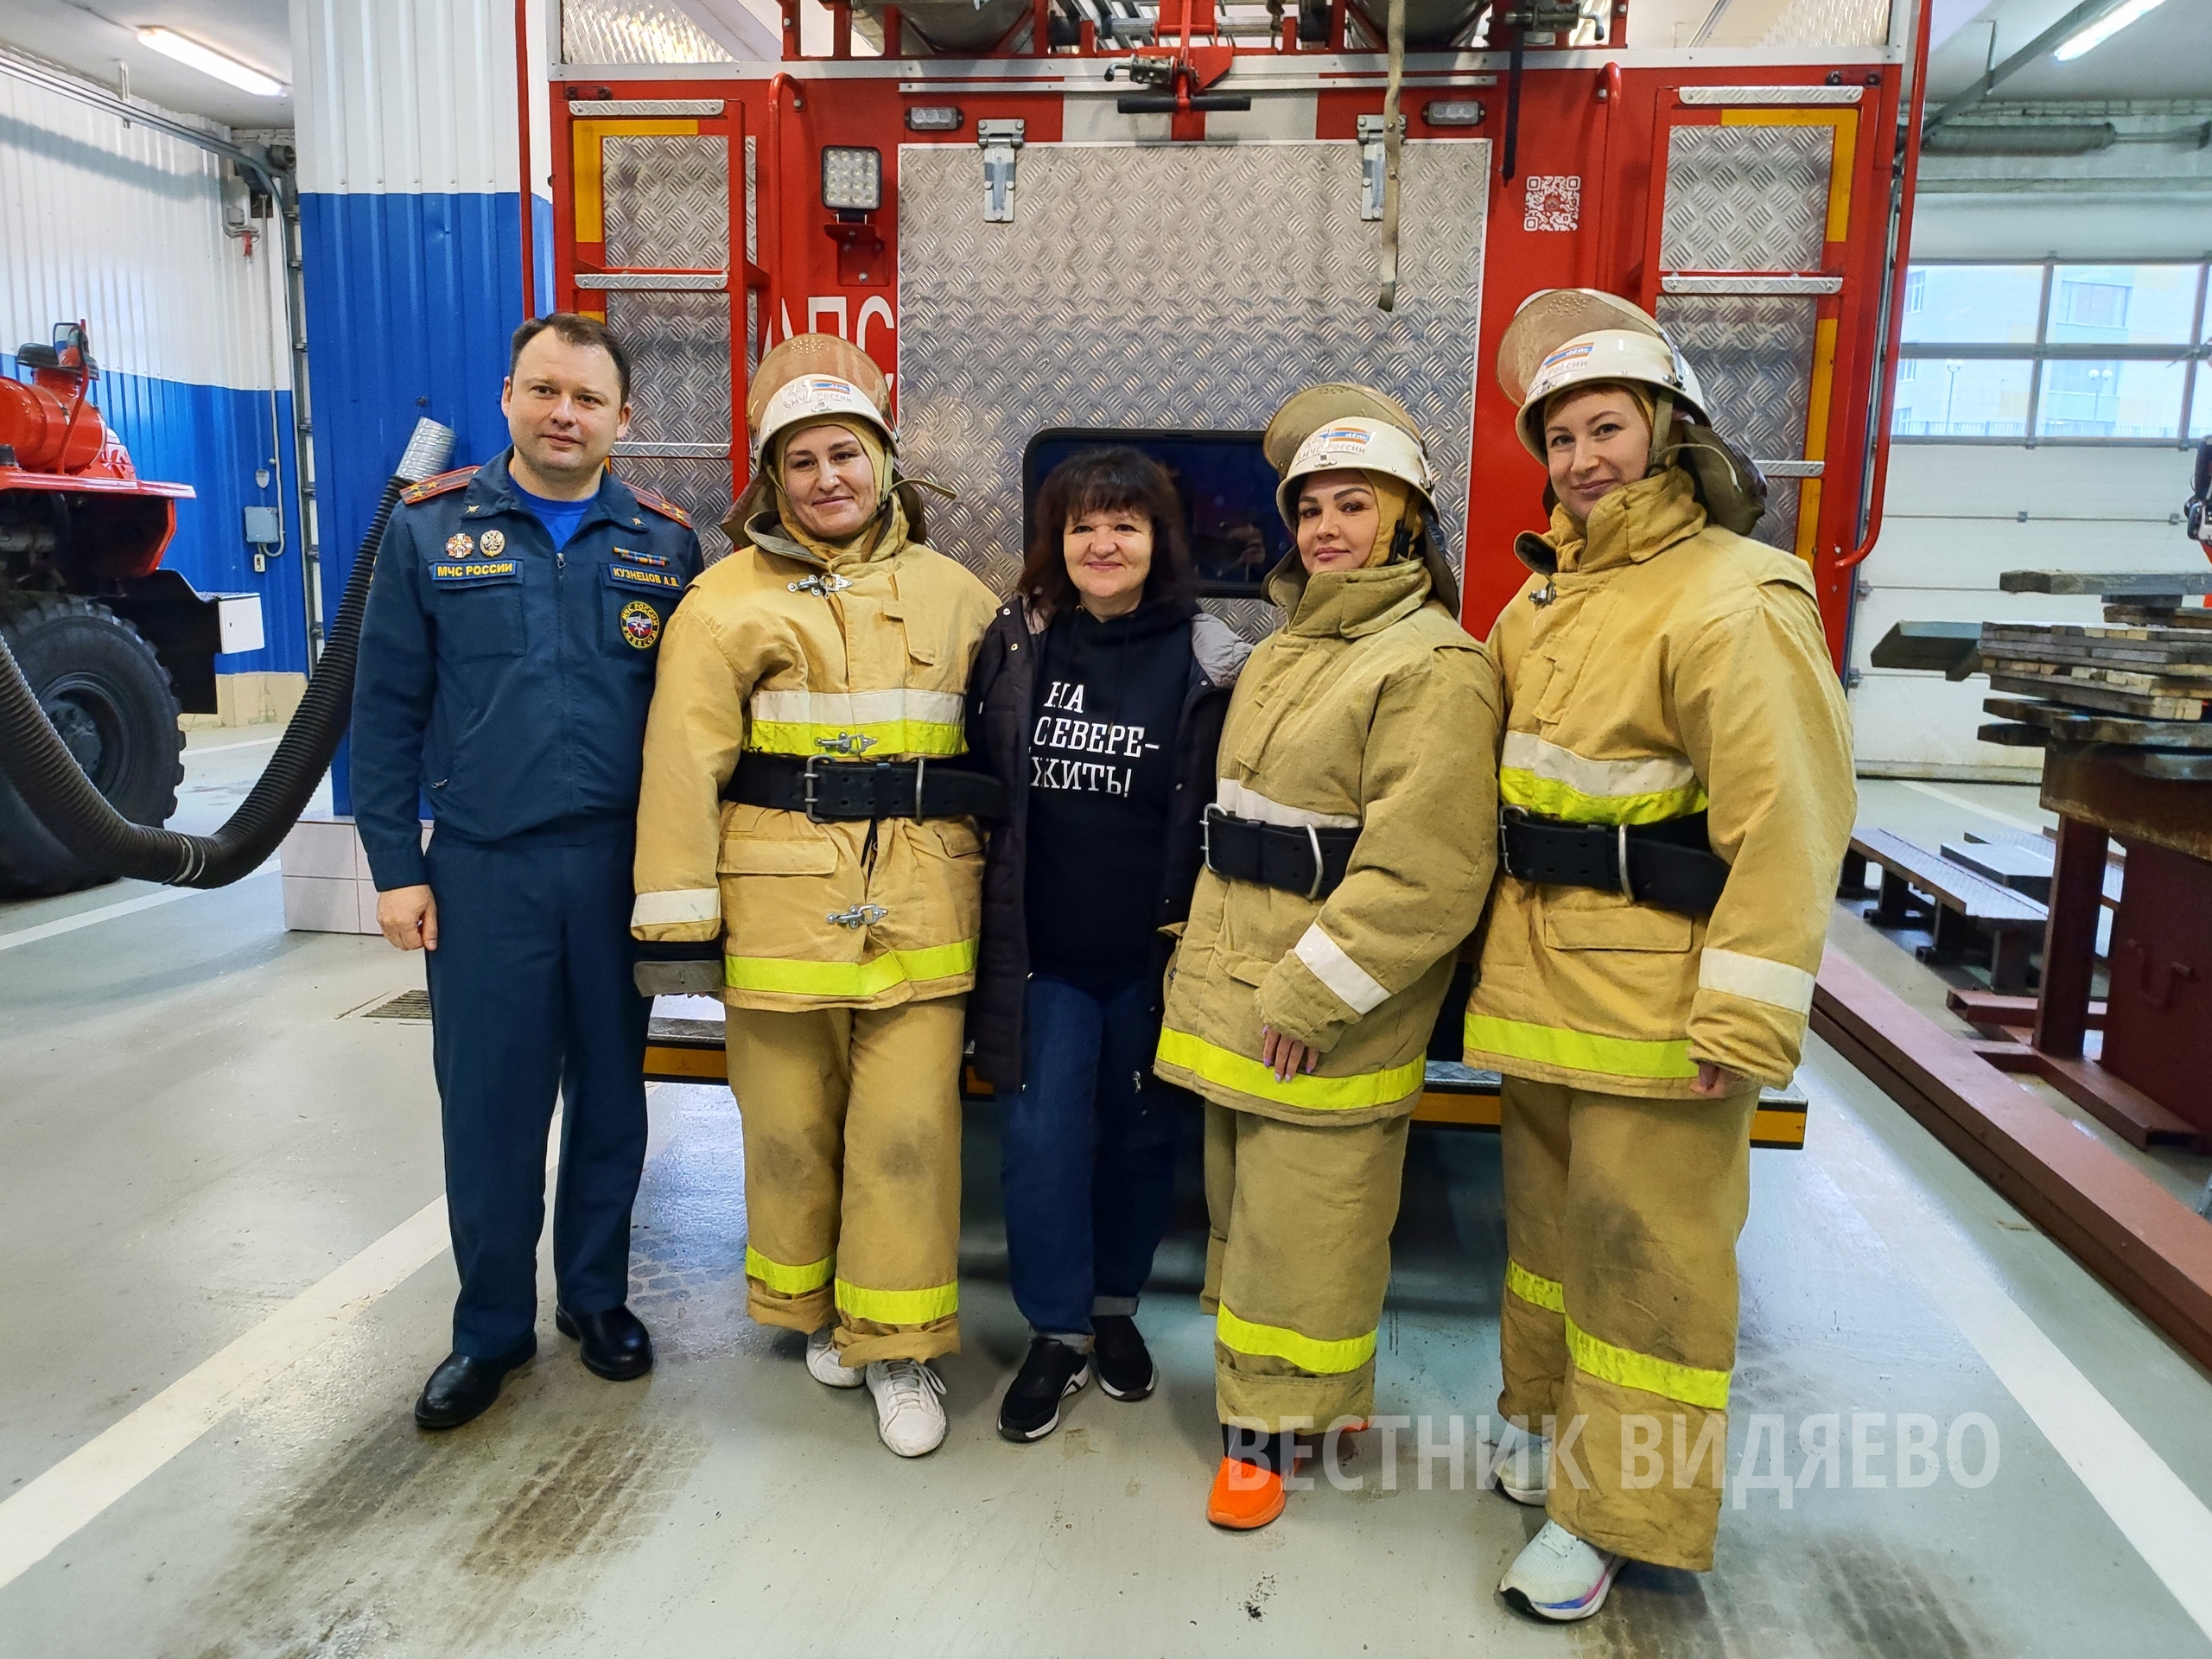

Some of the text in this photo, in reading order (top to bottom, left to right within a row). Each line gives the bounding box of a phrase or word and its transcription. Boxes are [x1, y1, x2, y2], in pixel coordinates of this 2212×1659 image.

[437, 563, 513, 577] МЧС РОССИИ
[613, 567, 680, 587] КУЗНЕЦОВ А.В.
[622, 603, 658, 626] МЧС РОССИИ
[1044, 681, 1084, 714] НА
[1033, 716, 1160, 758] СЕВЕРЕ-
[1030, 756, 1132, 798] ЖИТЬ!
